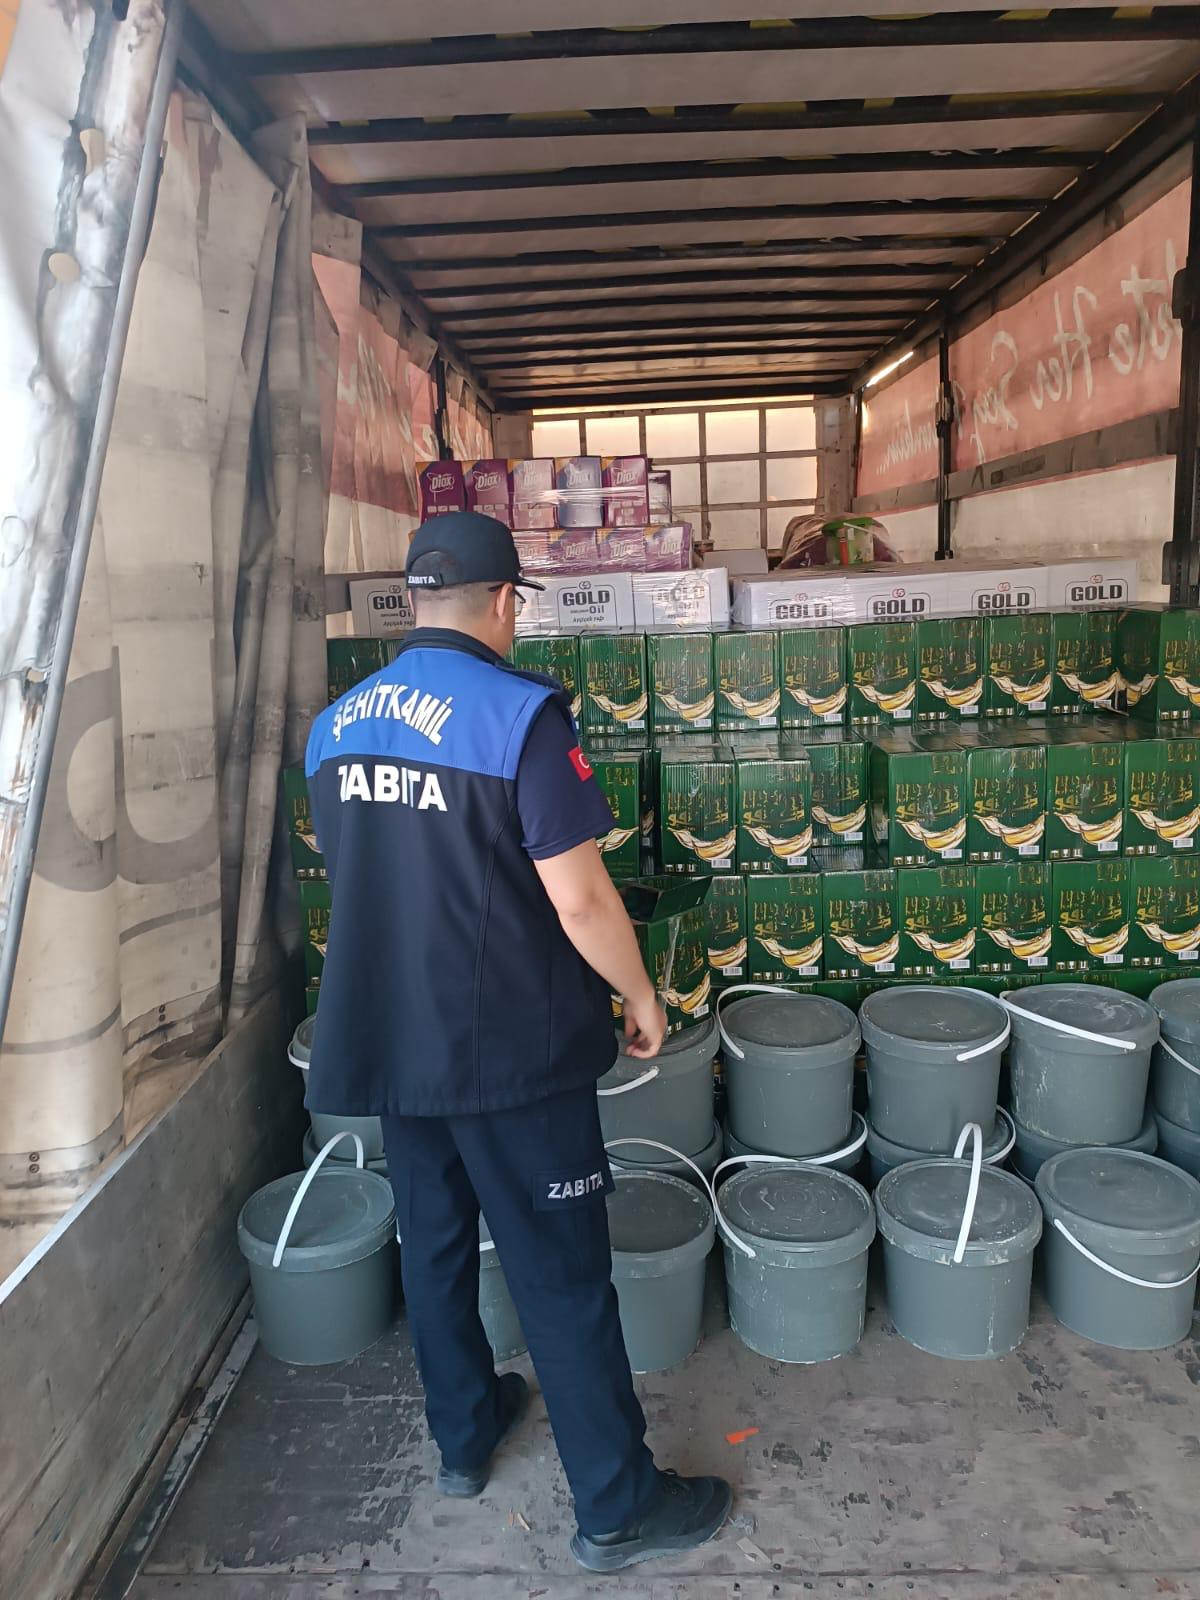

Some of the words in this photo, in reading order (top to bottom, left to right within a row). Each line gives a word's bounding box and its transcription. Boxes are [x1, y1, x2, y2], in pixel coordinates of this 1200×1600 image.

[562, 590, 610, 606] GOLD
[978, 592, 1031, 610] GOLD
[1071, 584, 1123, 602] GOLD
[373, 595, 411, 610] GOL
[589, 605, 605, 614] Oil
[873, 598, 925, 616] GOLD
[775, 604, 828, 620] GOLD
[332, 678, 453, 746] ŞEHİTKAMİL
[547, 1171, 604, 1199] ZABITA
